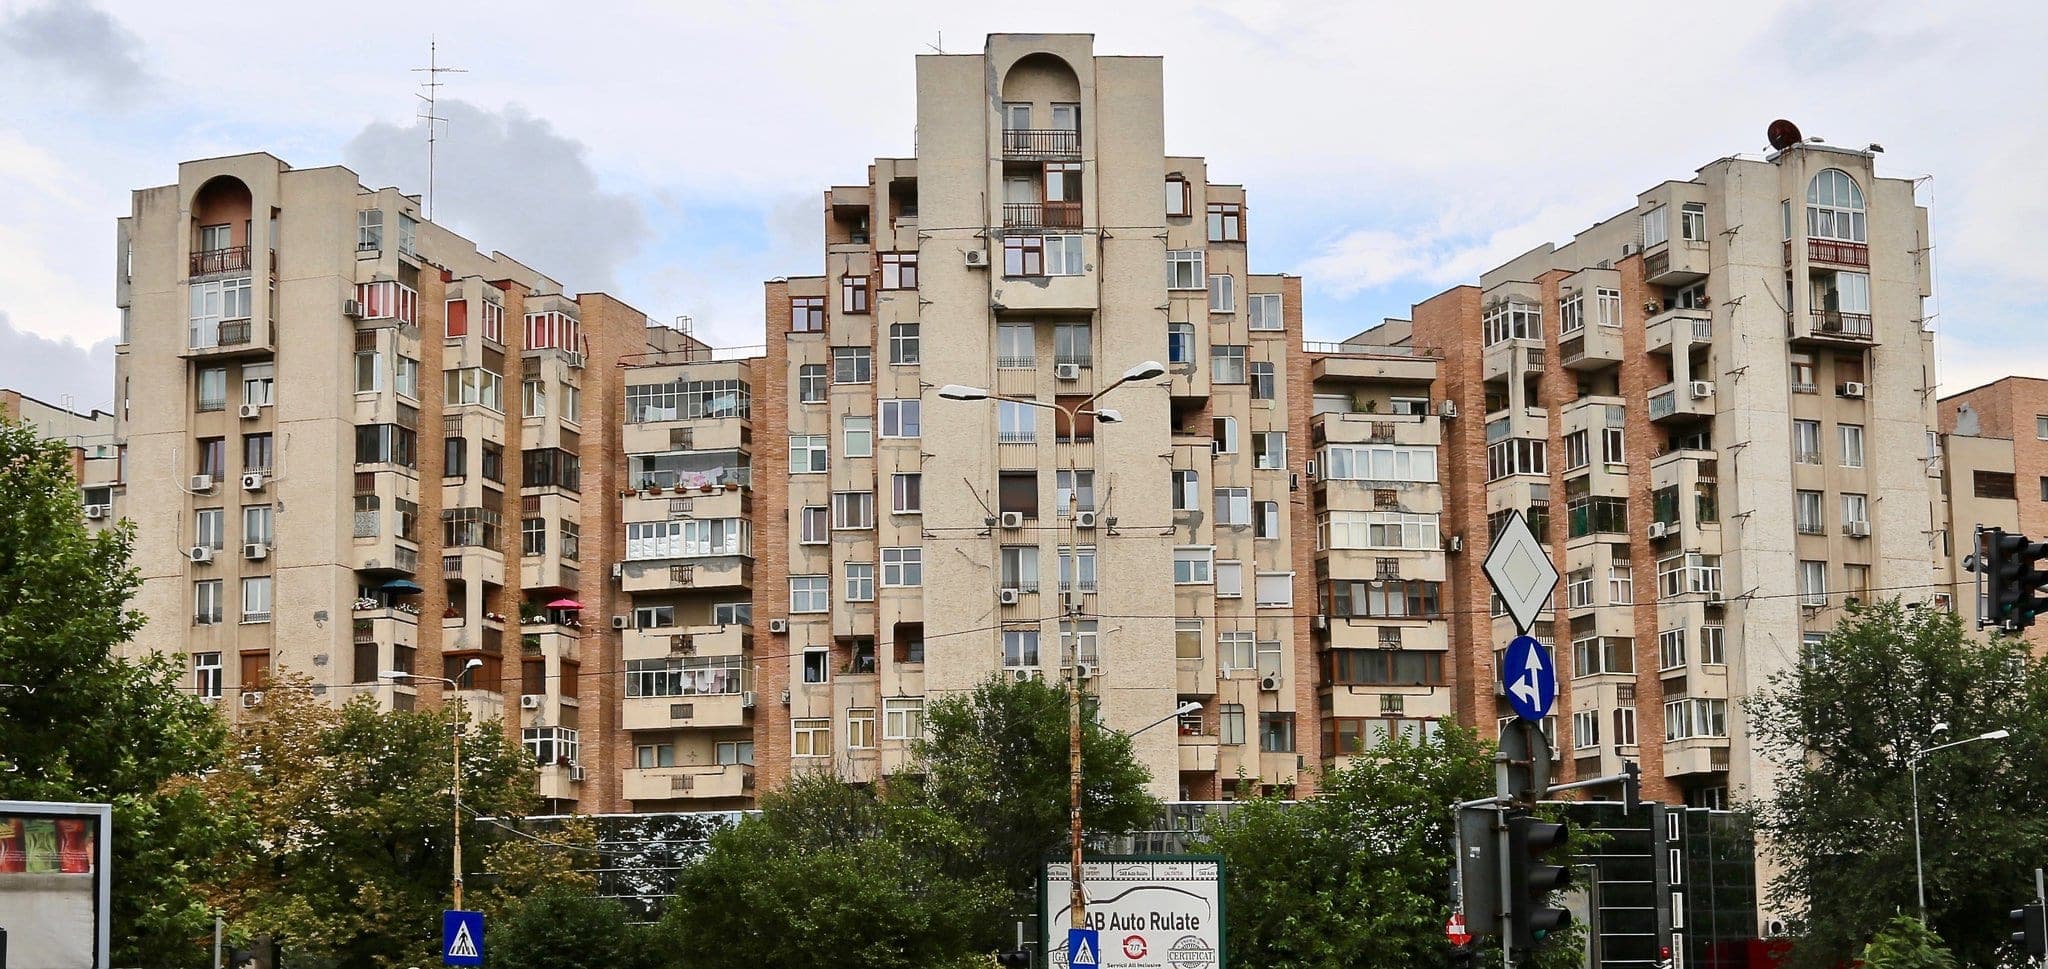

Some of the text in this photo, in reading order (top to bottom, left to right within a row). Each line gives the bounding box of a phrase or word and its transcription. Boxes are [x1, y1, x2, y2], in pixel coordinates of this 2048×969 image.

[1085, 911, 1200, 931] AB Auto Rulate
[1169, 951, 1212, 960] CERTIFICAT
